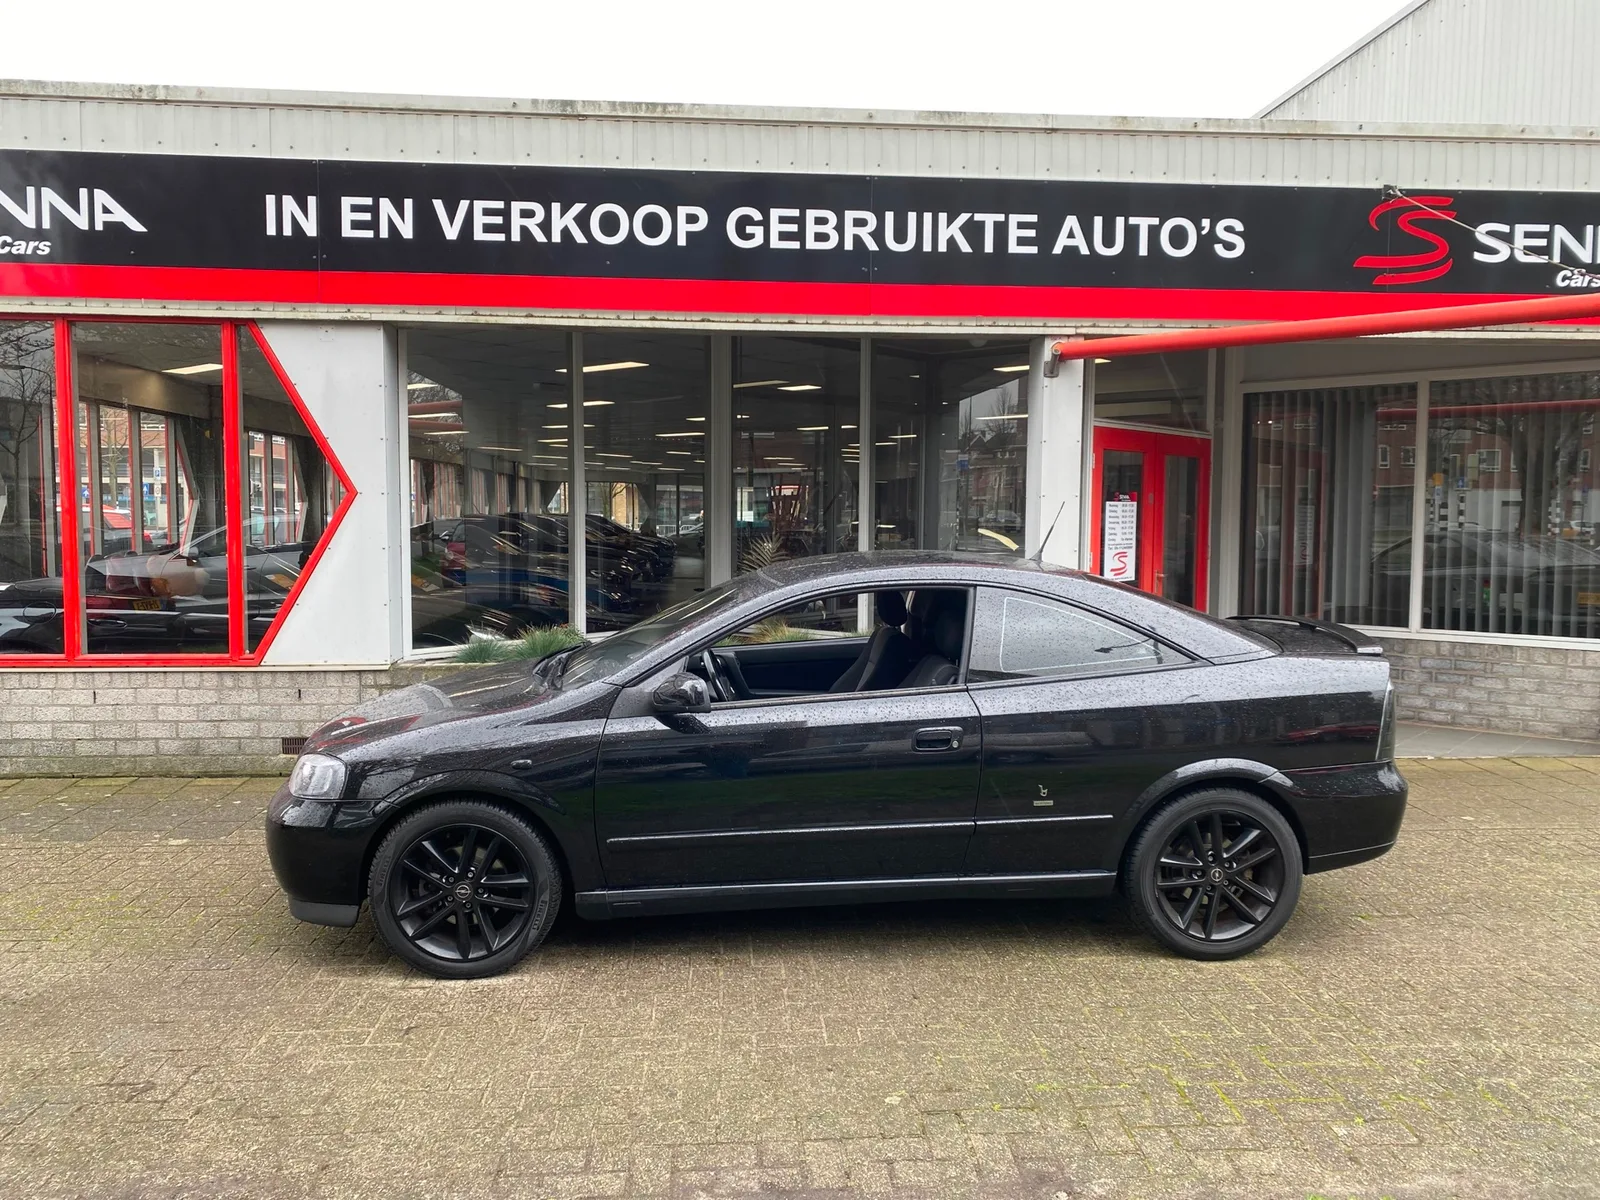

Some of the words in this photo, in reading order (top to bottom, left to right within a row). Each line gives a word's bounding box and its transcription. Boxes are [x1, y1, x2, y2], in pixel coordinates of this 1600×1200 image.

[0, 235, 52, 255] Cars
[265, 194, 318, 237] IN
[340, 196, 414, 240] EN
[431, 198, 709, 248] VERKOOP
[725, 206, 1039, 255] GEBRUIKTE
[1051, 214, 1246, 259] AUTO'S
[1473, 222, 1600, 264] SEN
